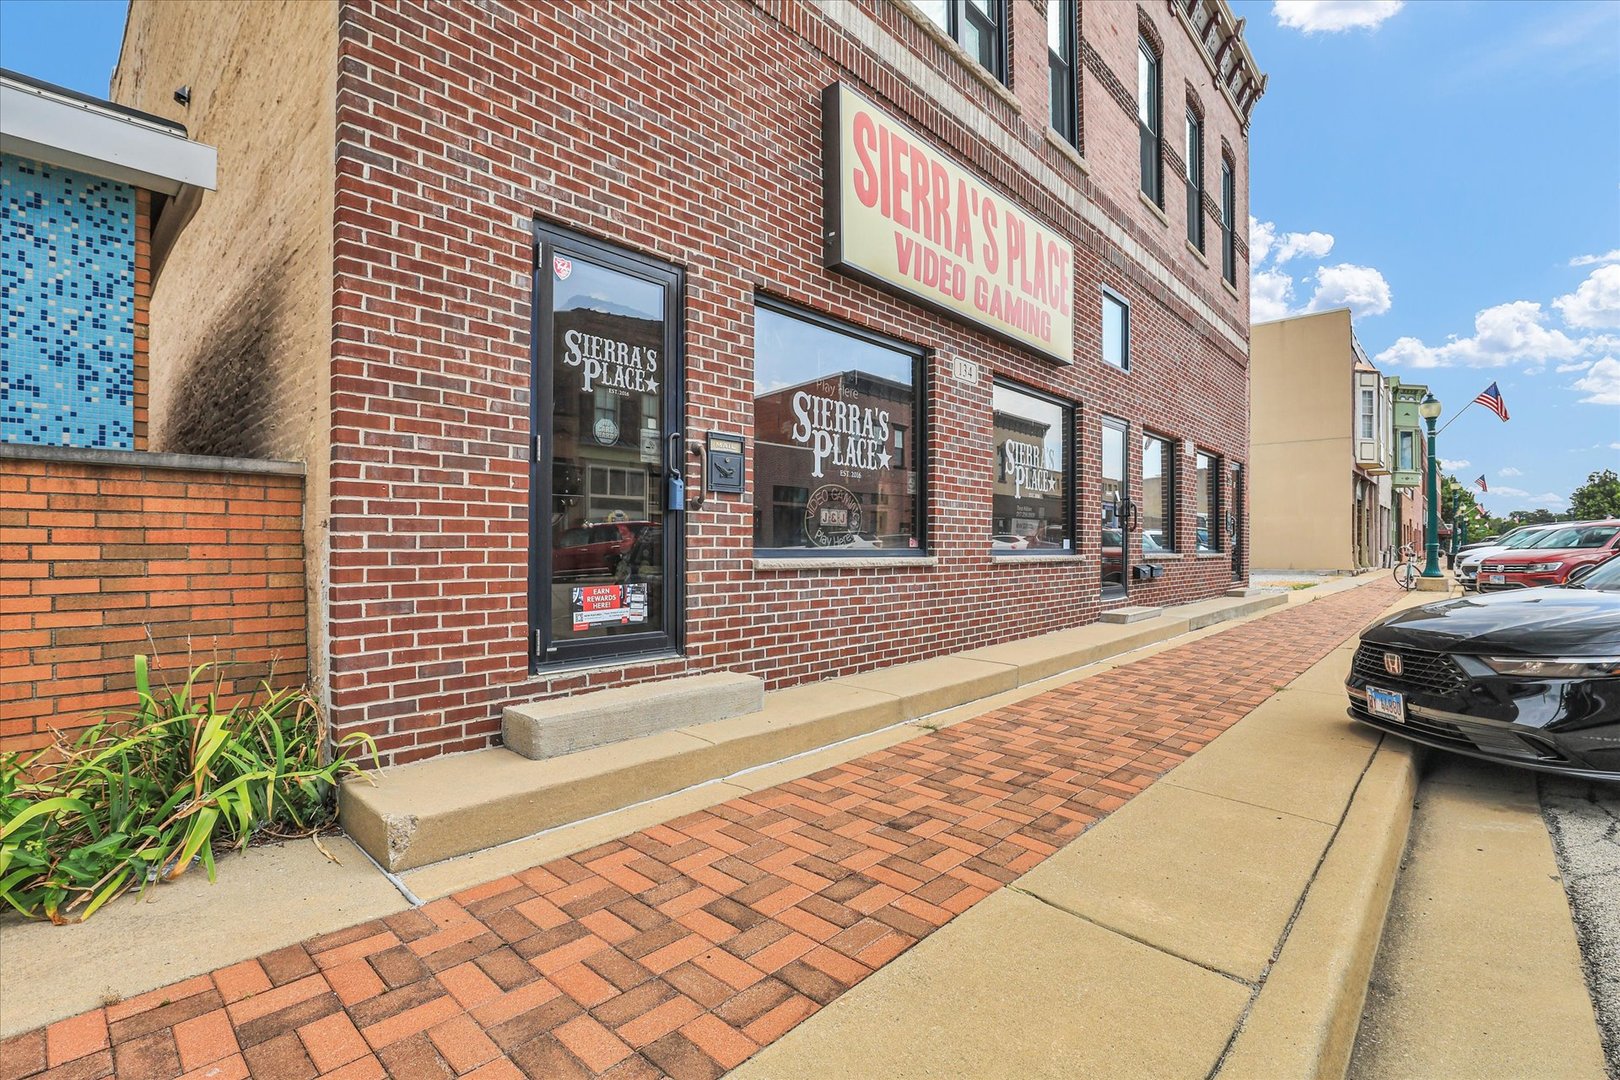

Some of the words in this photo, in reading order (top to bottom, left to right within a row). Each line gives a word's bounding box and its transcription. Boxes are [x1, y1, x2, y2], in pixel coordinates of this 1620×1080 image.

[853, 111, 999, 275] SIERRA'S
[1006, 210, 1069, 317] PLACE
[894, 231, 967, 302] VIDEO
[974, 274, 1052, 343] GAMING
[564, 329, 658, 373] SIERRA'S
[581, 358, 648, 393] PLACE
[959, 362, 973, 378] 134
[816, 379, 836, 397] Play
[837, 383, 859, 400] Here
[792, 391, 890, 443] SIERRA'S
[716, 441, 737, 450] MAIL
[811, 430, 878, 478] PLACE
[1014, 465, 1048, 499] PLACE
[806, 489, 829, 519] VIDEO
[831, 488, 860, 526] GAMING
[814, 528, 832, 546] Play
[586, 595, 617, 603] REWARDS
